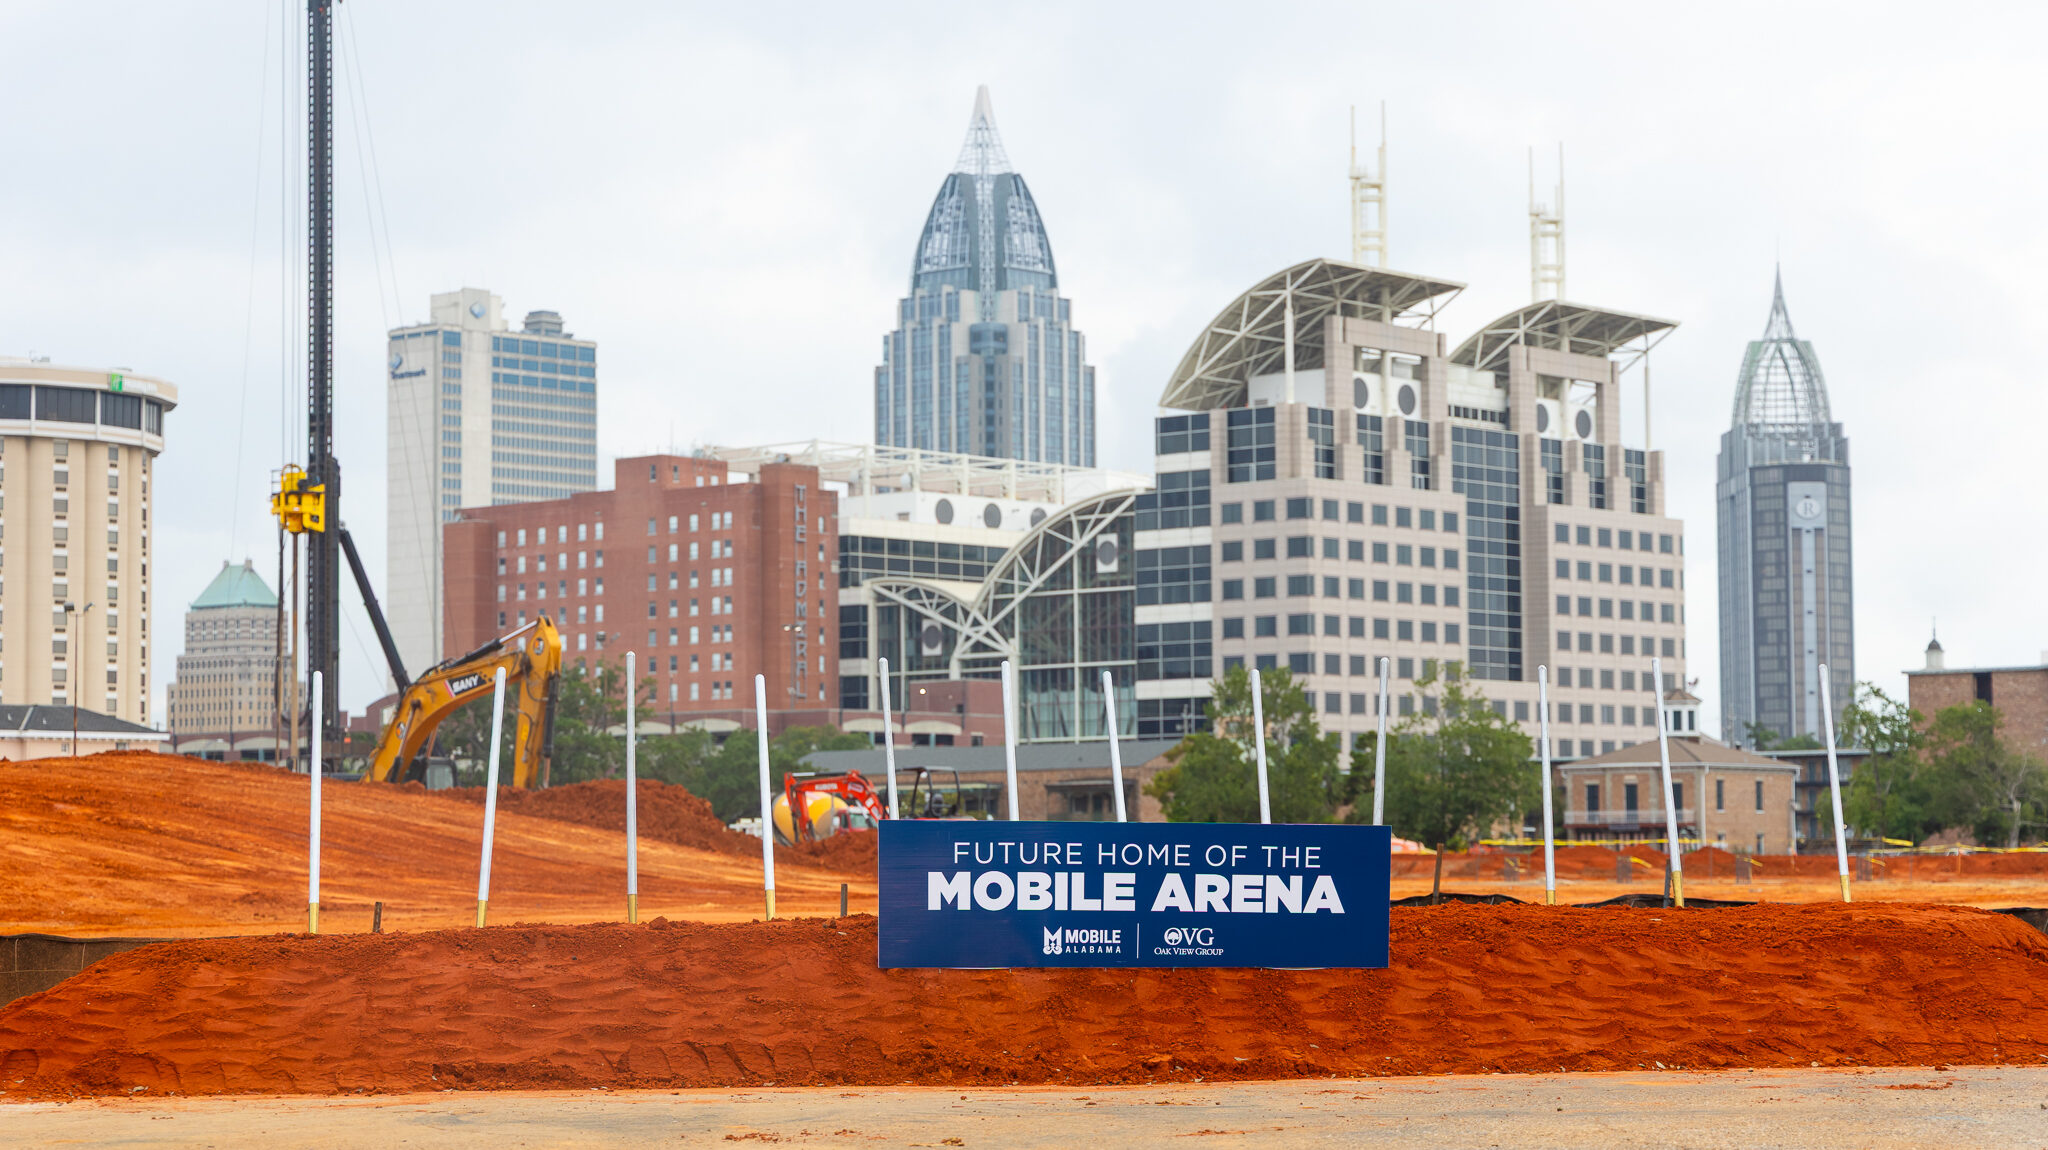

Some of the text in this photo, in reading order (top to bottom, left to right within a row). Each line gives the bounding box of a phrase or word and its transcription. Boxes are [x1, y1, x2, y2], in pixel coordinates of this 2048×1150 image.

[794, 484, 808, 699] THE ADMIRAL
[452, 675, 479, 694] SANY
[954, 841, 1321, 869] FUTURE HOME OF THE
[927, 870, 1346, 914] MOBILE ARENA
[1065, 929, 1122, 944] MOBILE
[1163, 927, 1215, 946] OVG
[1065, 945, 1122, 954] ALABAMA
